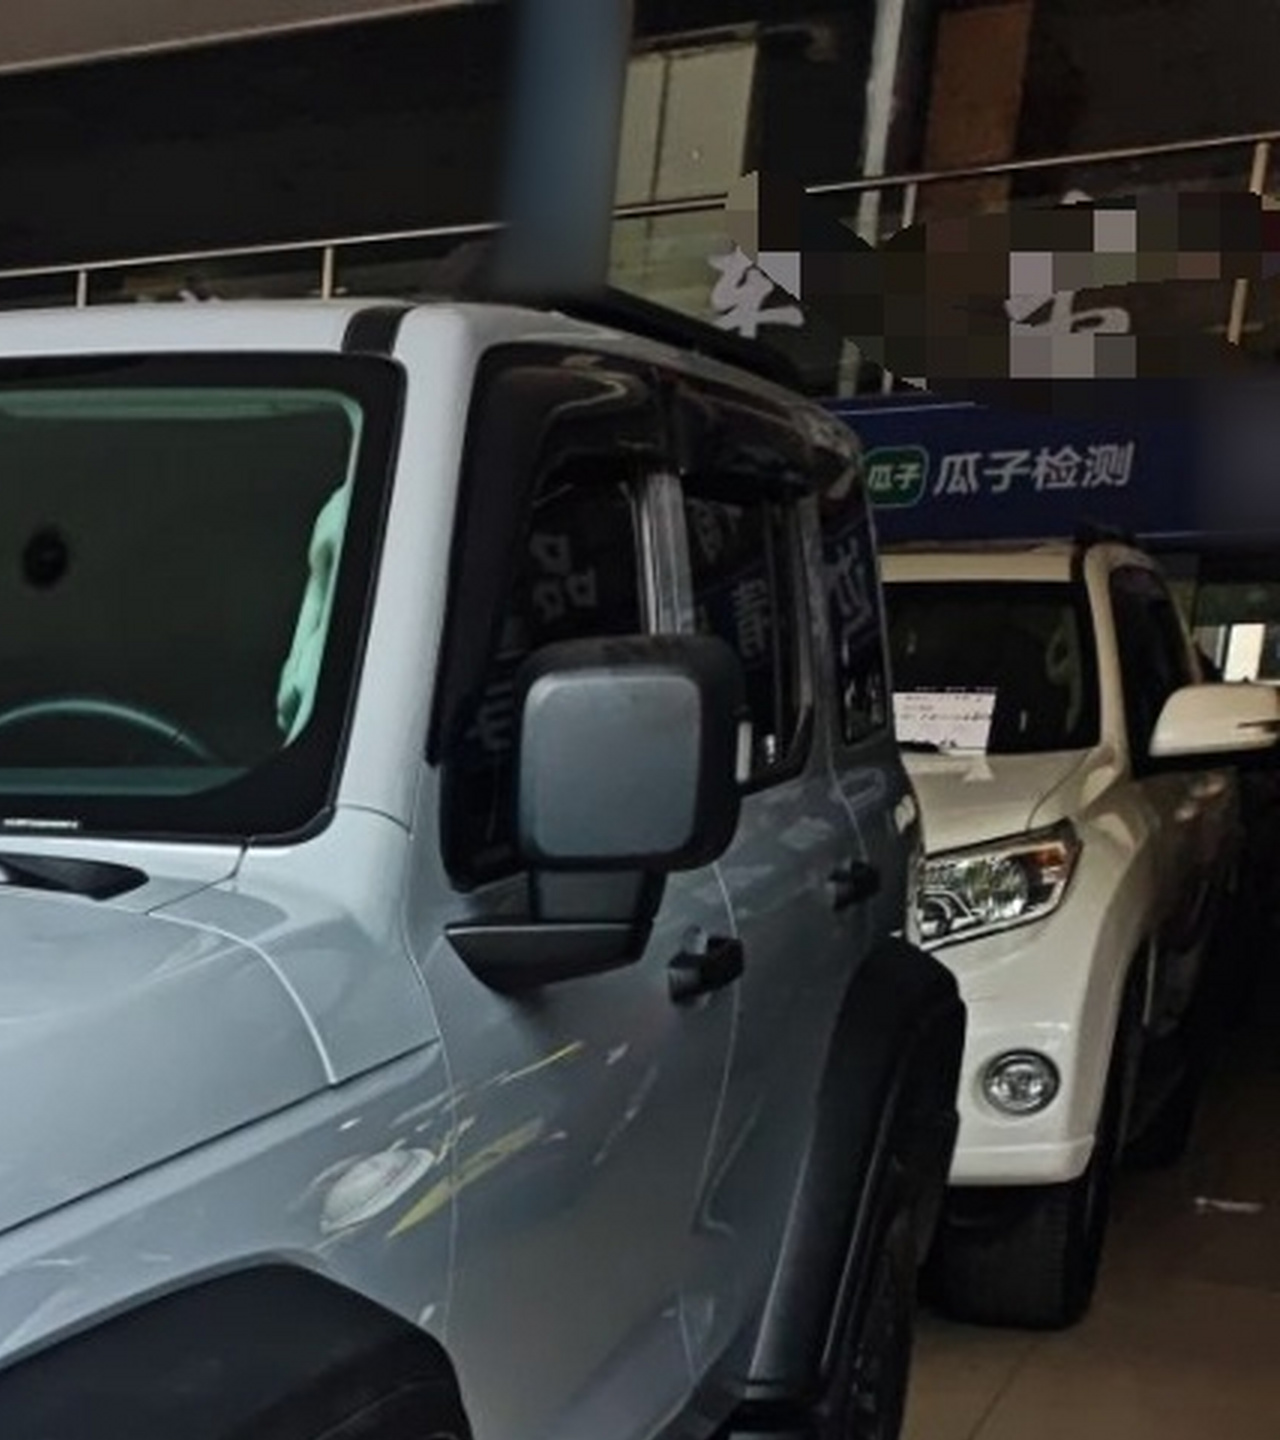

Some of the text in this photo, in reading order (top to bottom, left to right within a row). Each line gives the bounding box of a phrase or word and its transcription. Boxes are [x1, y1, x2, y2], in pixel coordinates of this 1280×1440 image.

[867, 441, 1135, 495] 瓜子 瓜子检测
